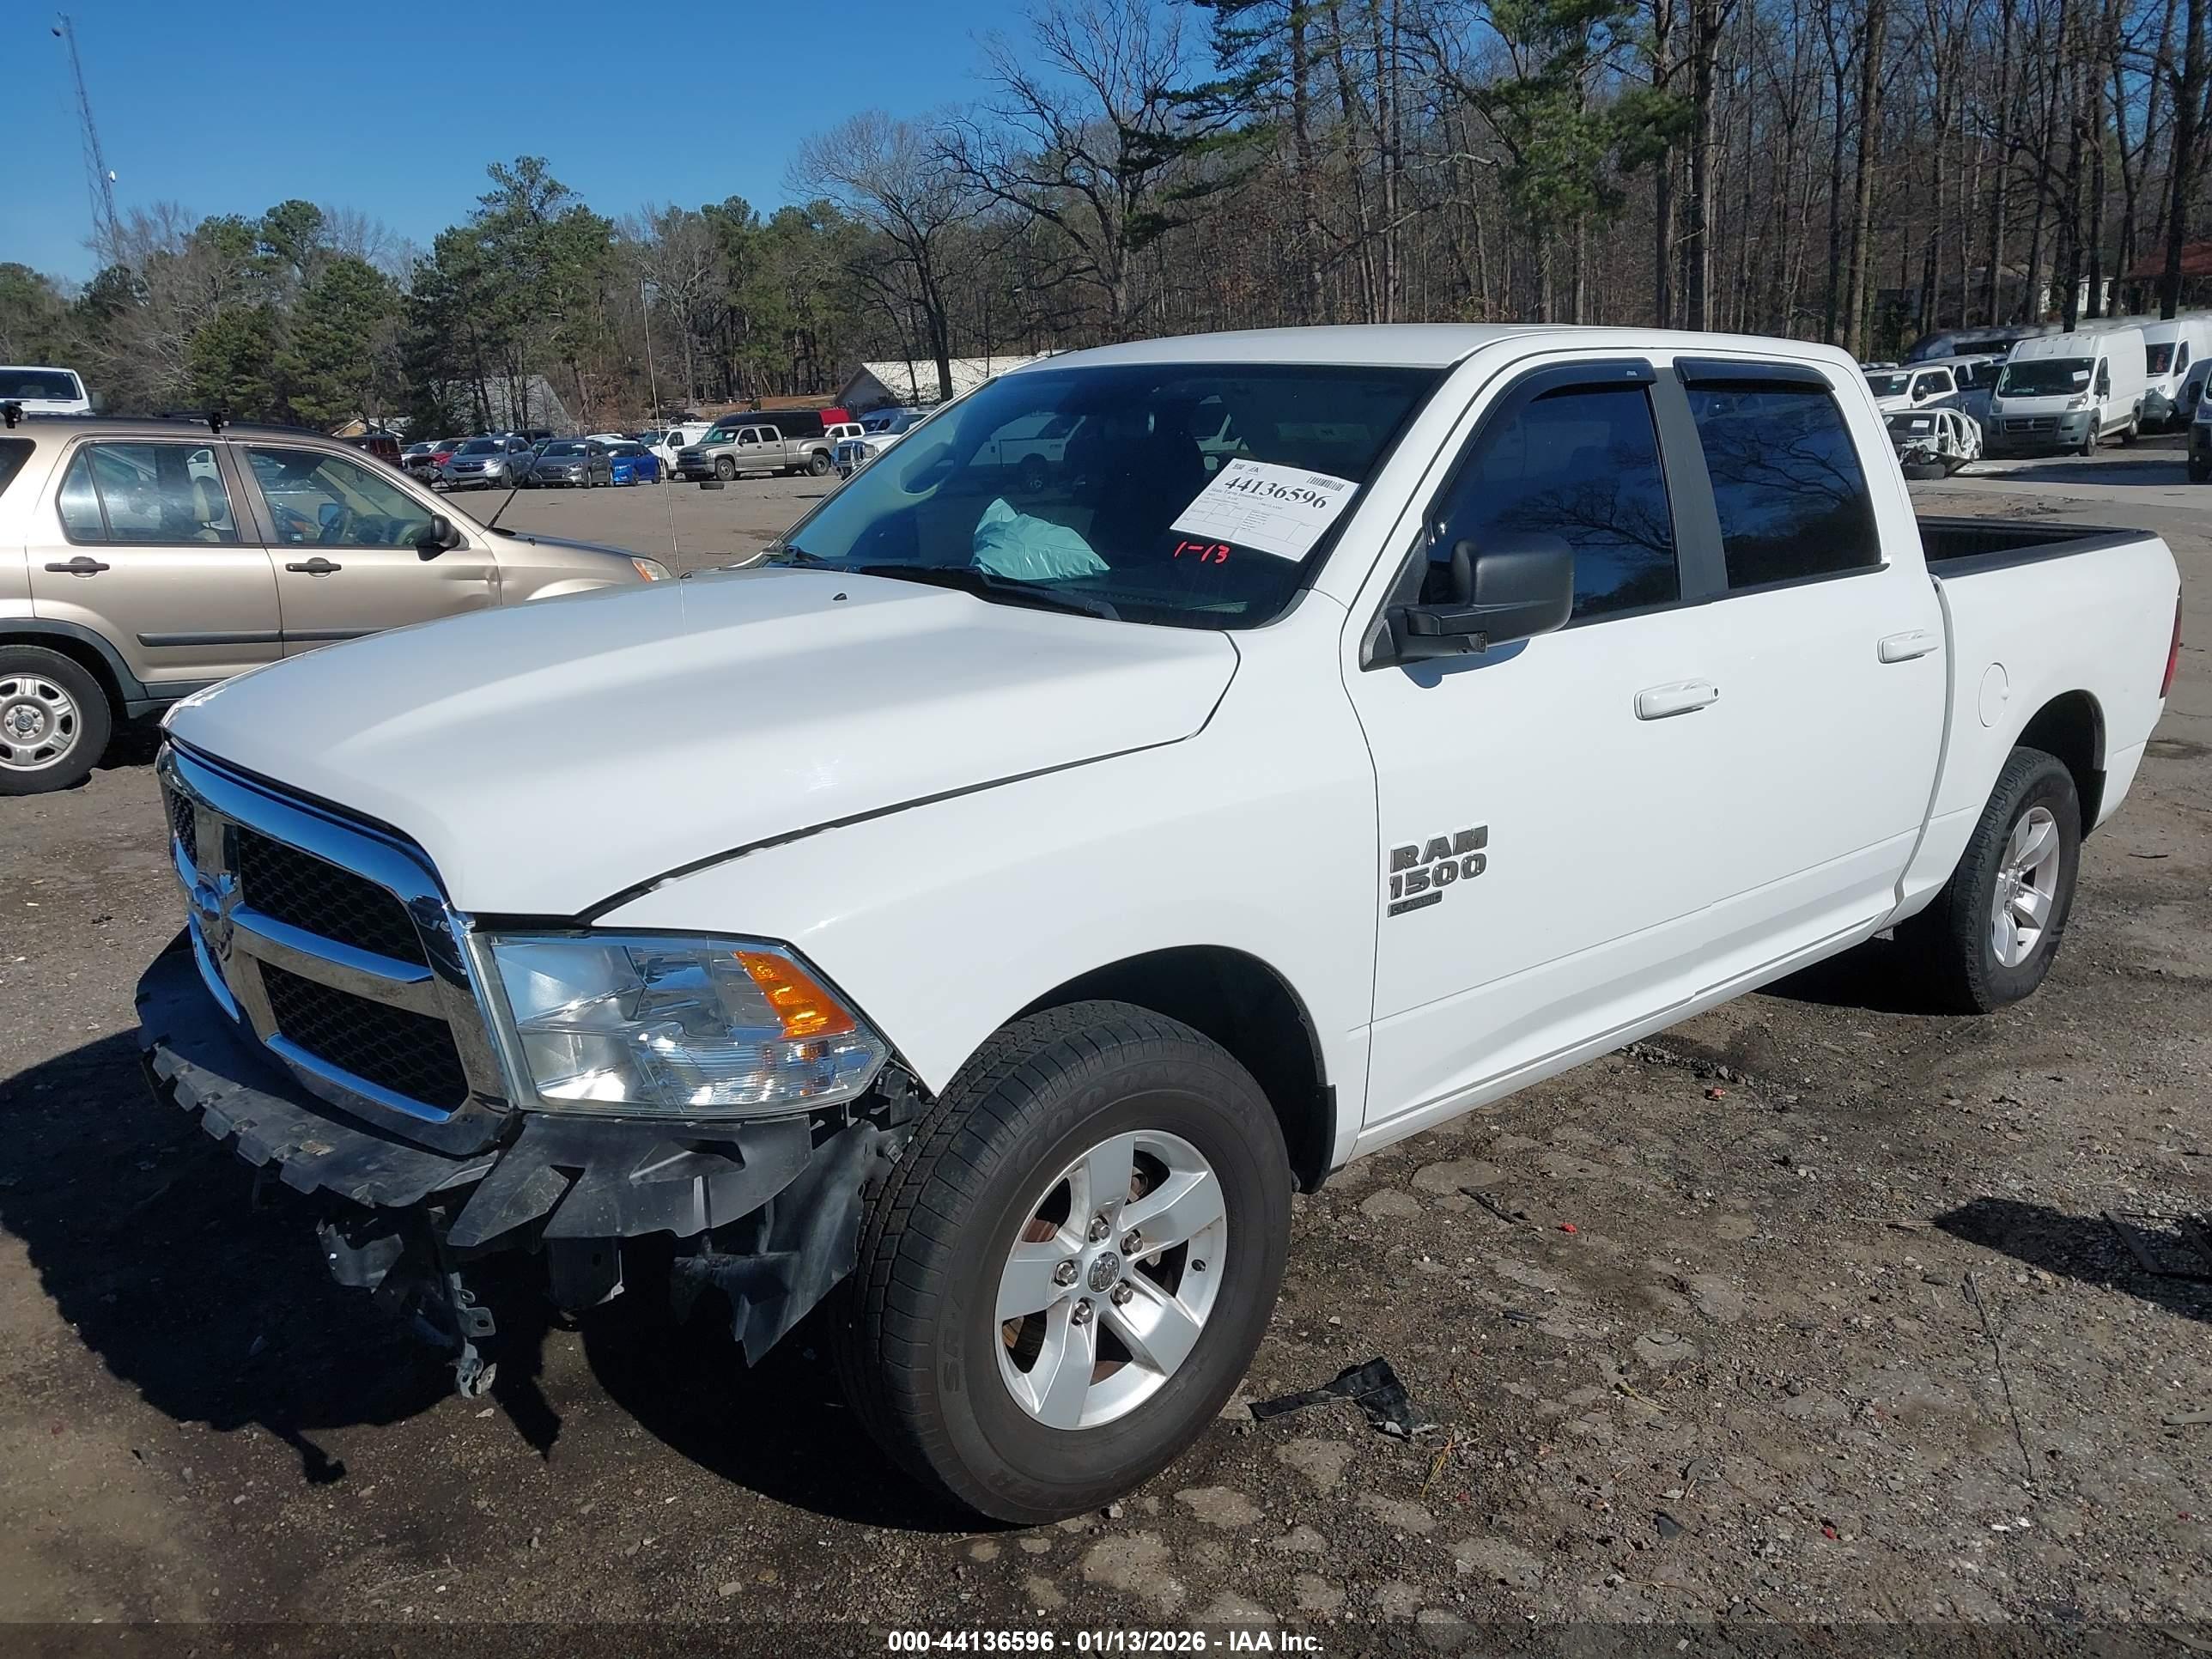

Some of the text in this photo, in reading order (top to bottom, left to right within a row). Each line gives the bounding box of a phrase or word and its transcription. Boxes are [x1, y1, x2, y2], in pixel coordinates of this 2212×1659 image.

[1224, 476, 1334, 509] 44136596
[1174, 541, 1230, 563] 1-13
[1389, 824, 1488, 873] RAM
[1389, 853, 1487, 901] 1500
